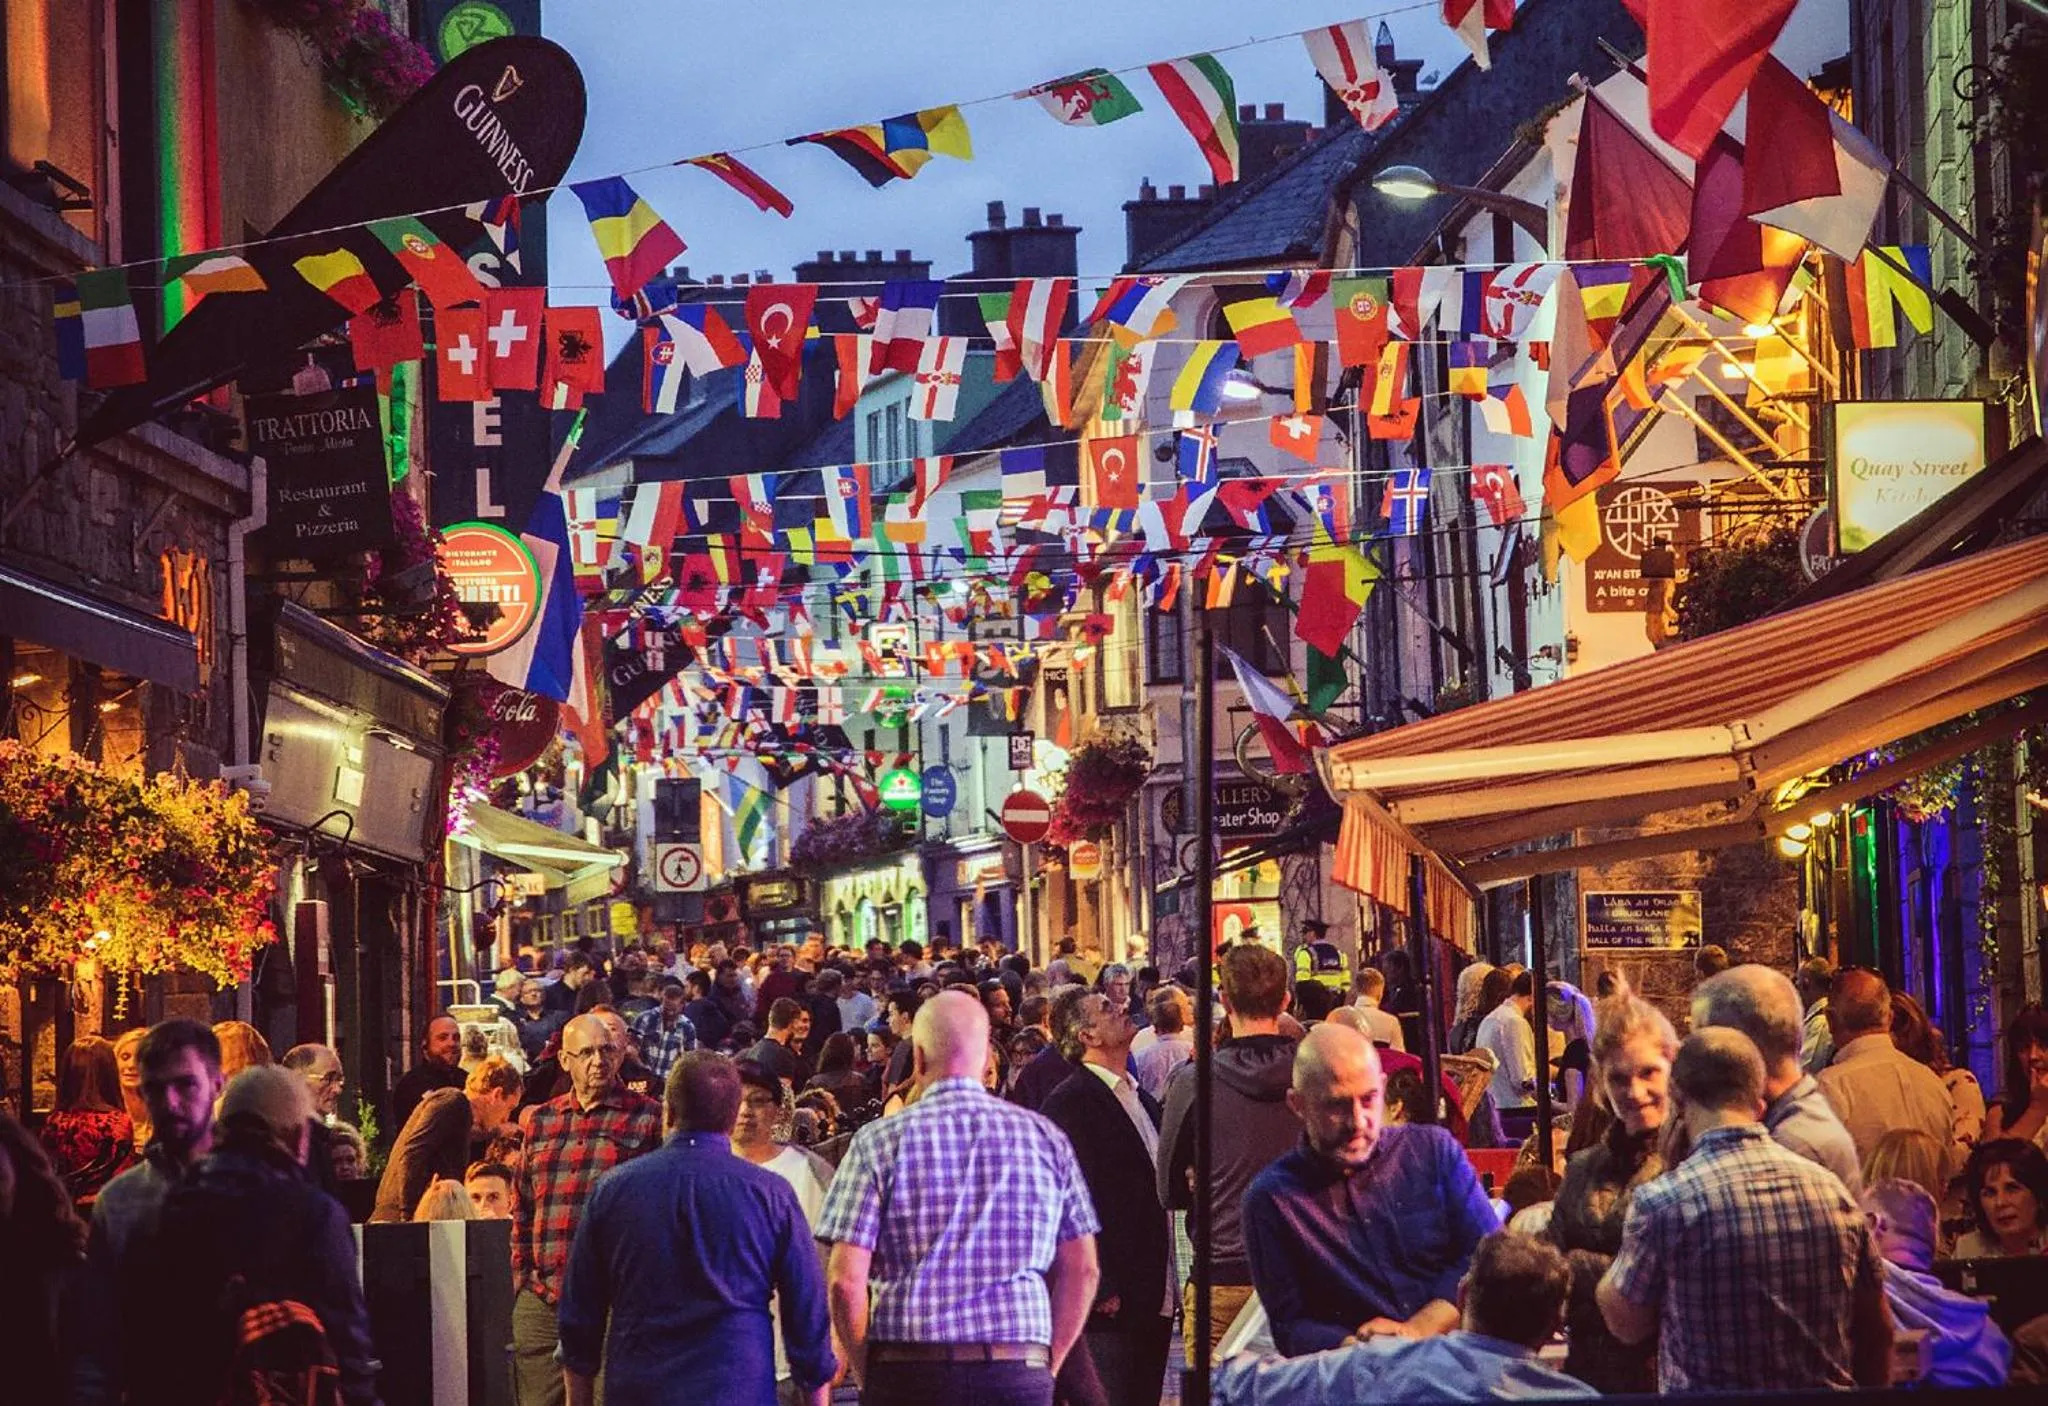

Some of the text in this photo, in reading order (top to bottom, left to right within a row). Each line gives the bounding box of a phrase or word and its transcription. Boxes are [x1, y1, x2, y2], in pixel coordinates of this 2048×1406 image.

[454, 85, 534, 194] GUINNESS
[253, 408, 373, 442] TRATTORIA
[1850, 457, 1969, 482] Quay Street
[279, 481, 368, 503] Restaurant
[318, 503, 331, 517] &
[295, 518, 359, 538] Pizzeria
[451, 558, 493, 567] ITALIANO
[1596, 587, 1607, 597] A
[1610, 585, 1636, 597] bite
[1248, 807, 1280, 829] Shop
